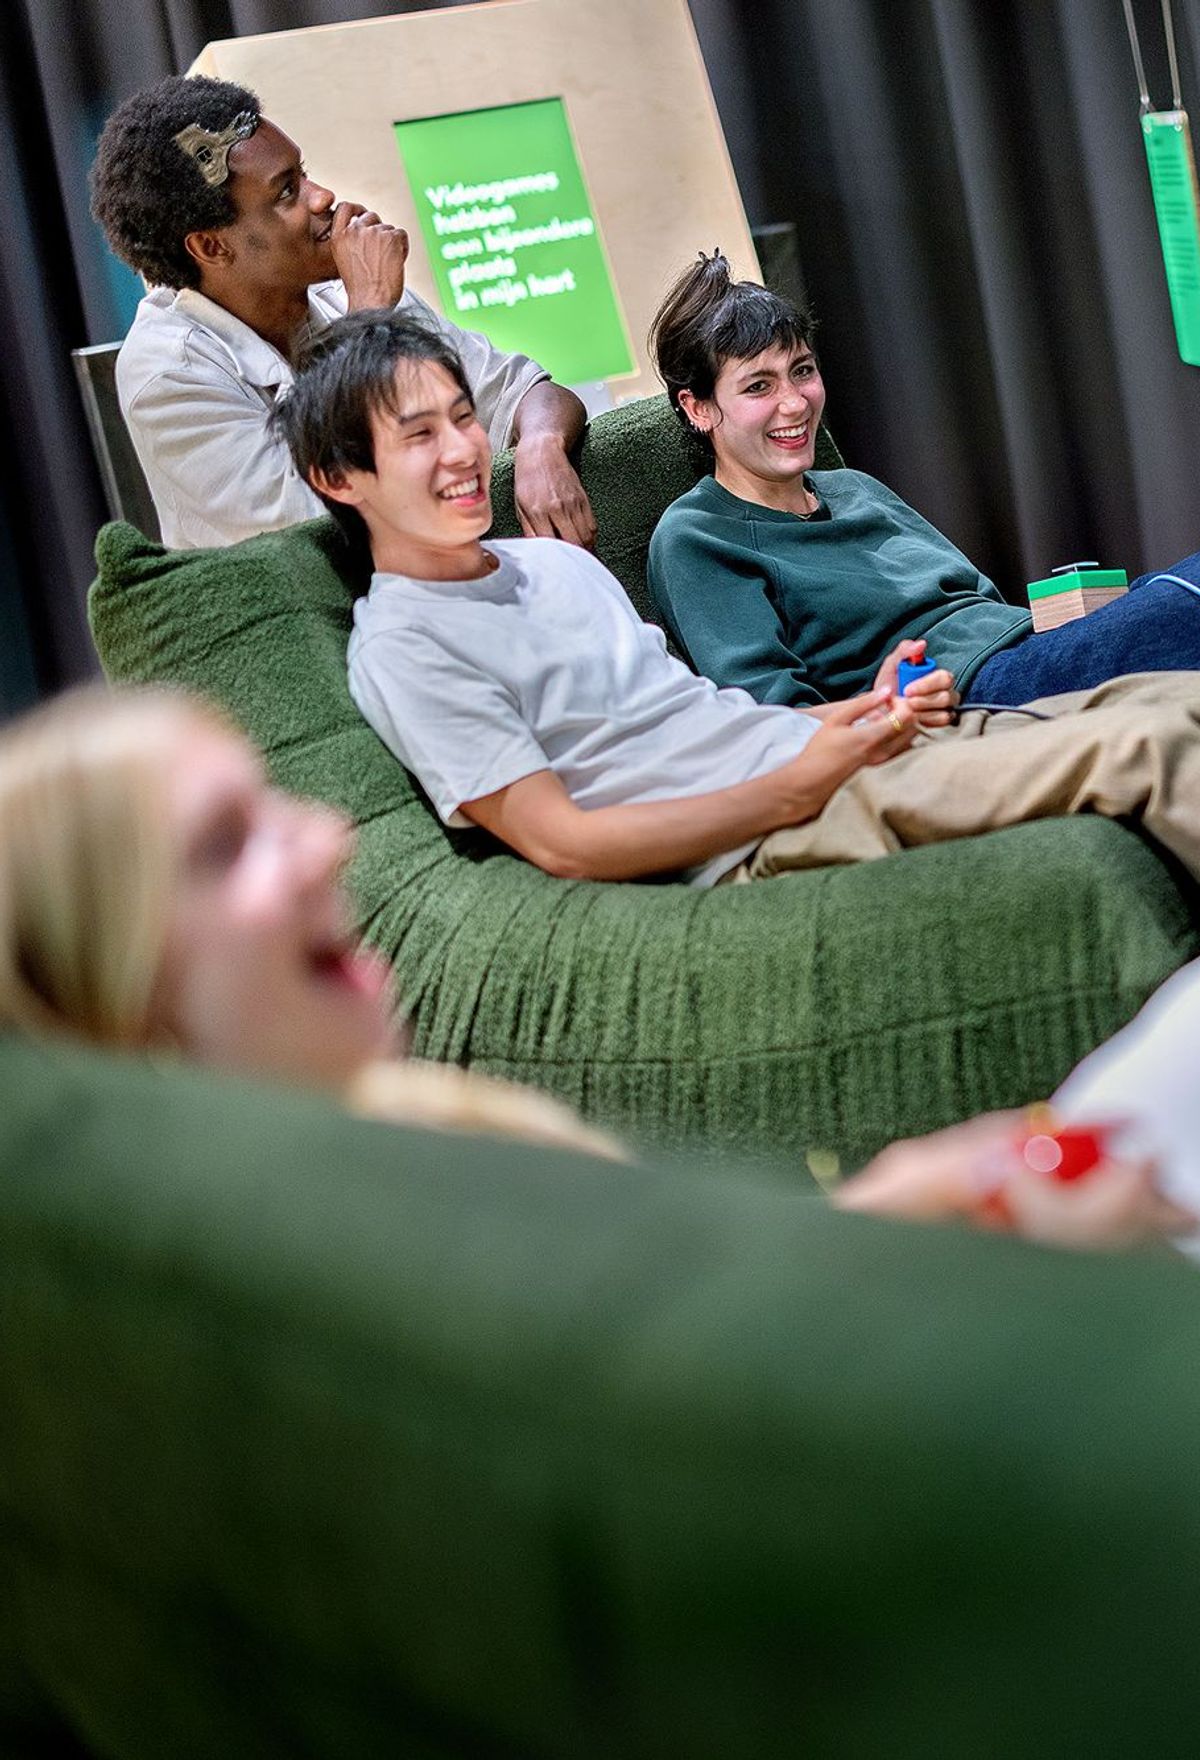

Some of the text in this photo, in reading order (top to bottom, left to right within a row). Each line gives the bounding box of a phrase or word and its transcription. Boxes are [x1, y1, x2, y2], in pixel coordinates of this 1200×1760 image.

[426, 171, 559, 208] Videogames
[433, 205, 517, 235] hebben
[442, 217, 594, 260] een bijzondere
[448, 255, 517, 289] plaats
[455, 269, 576, 311] in mijn hart
